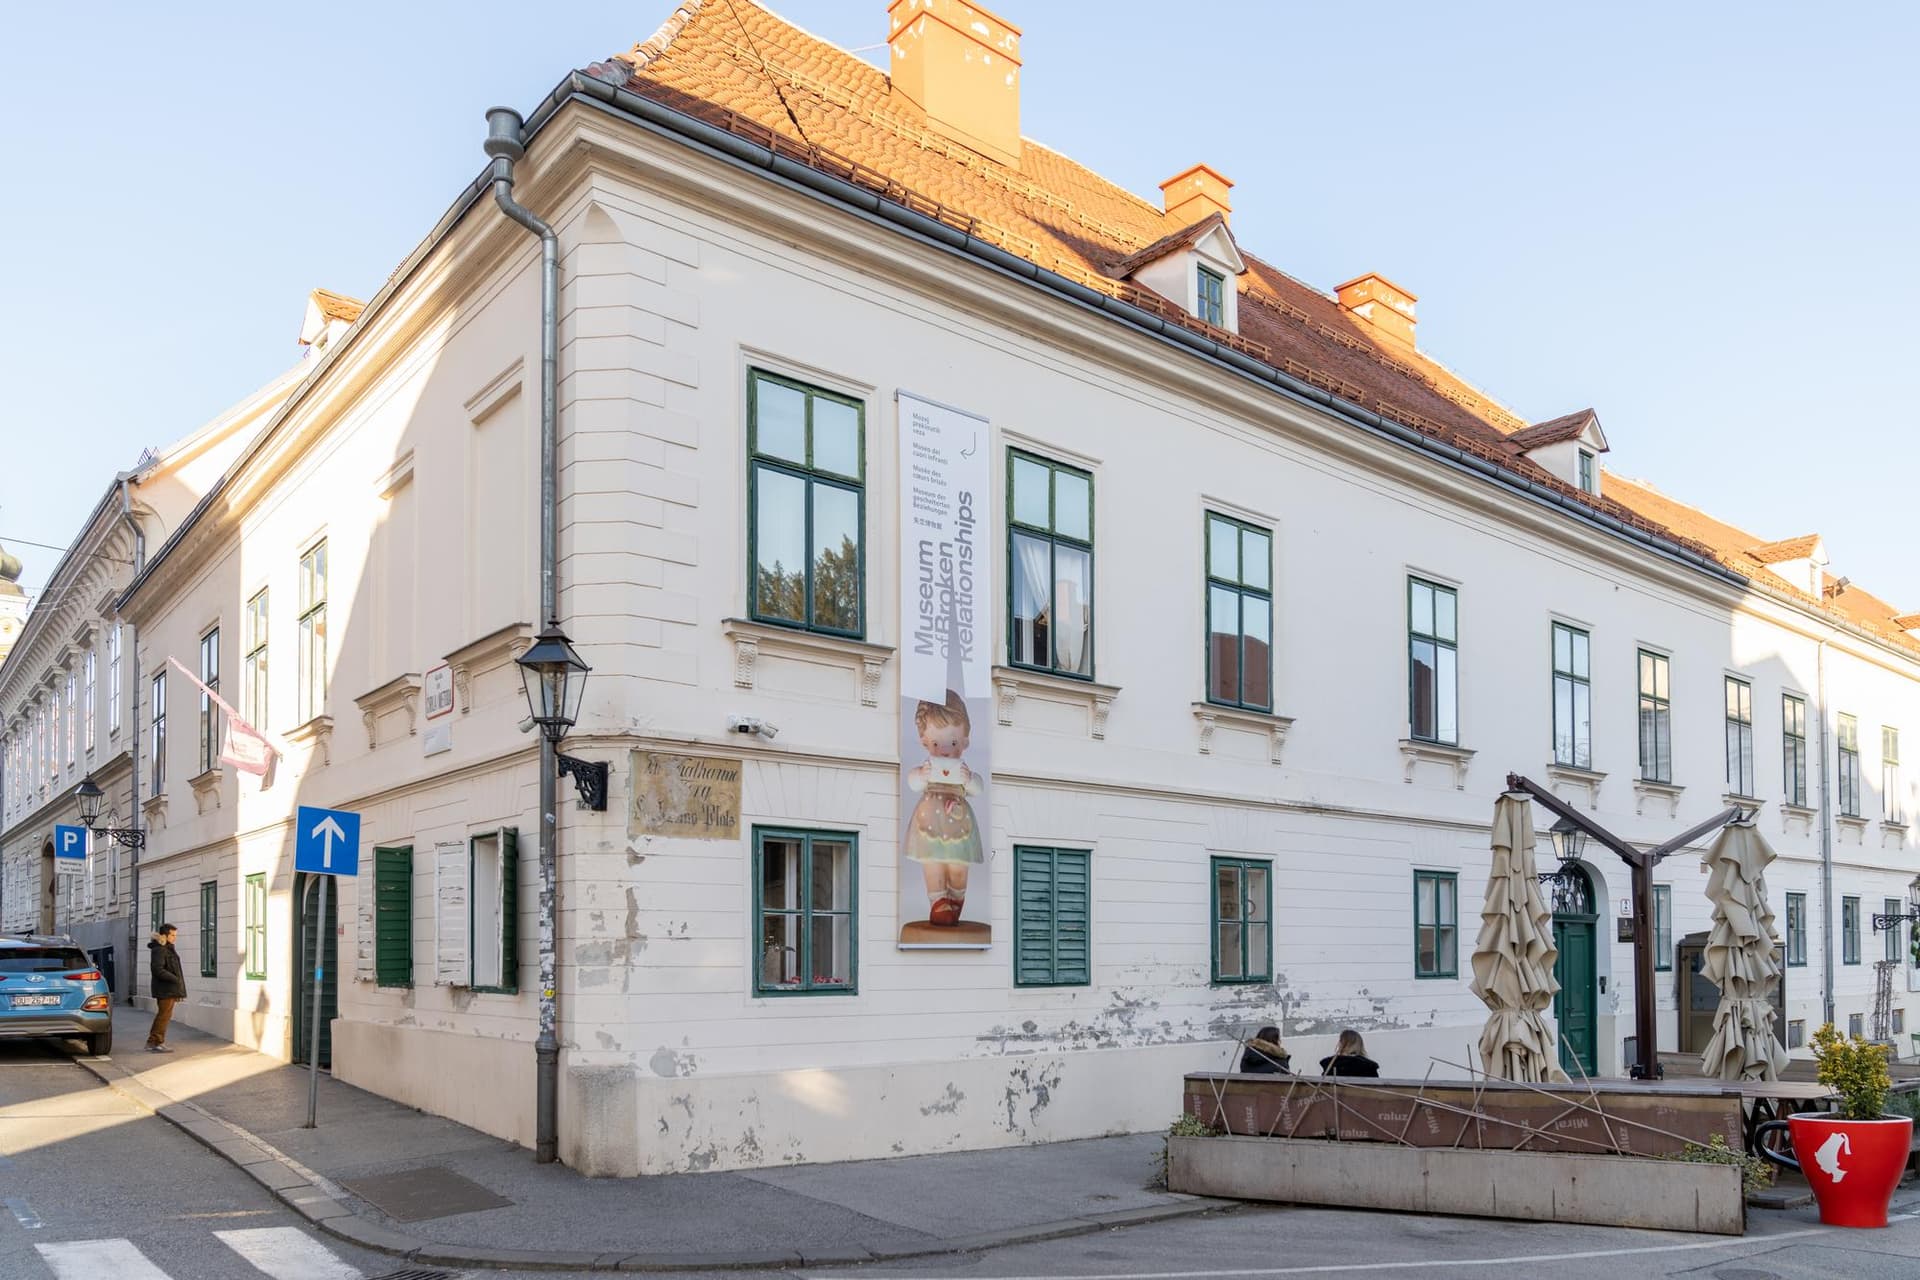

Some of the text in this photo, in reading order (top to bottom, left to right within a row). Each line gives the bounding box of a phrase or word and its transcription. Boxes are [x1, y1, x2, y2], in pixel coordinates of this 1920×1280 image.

[914, 540, 934, 656] Museum
[934, 541, 953, 634] Broken
[954, 490, 976, 663] Relationships
[64, 831, 78, 851] P
[1378, 1112, 1409, 1121] raluz
